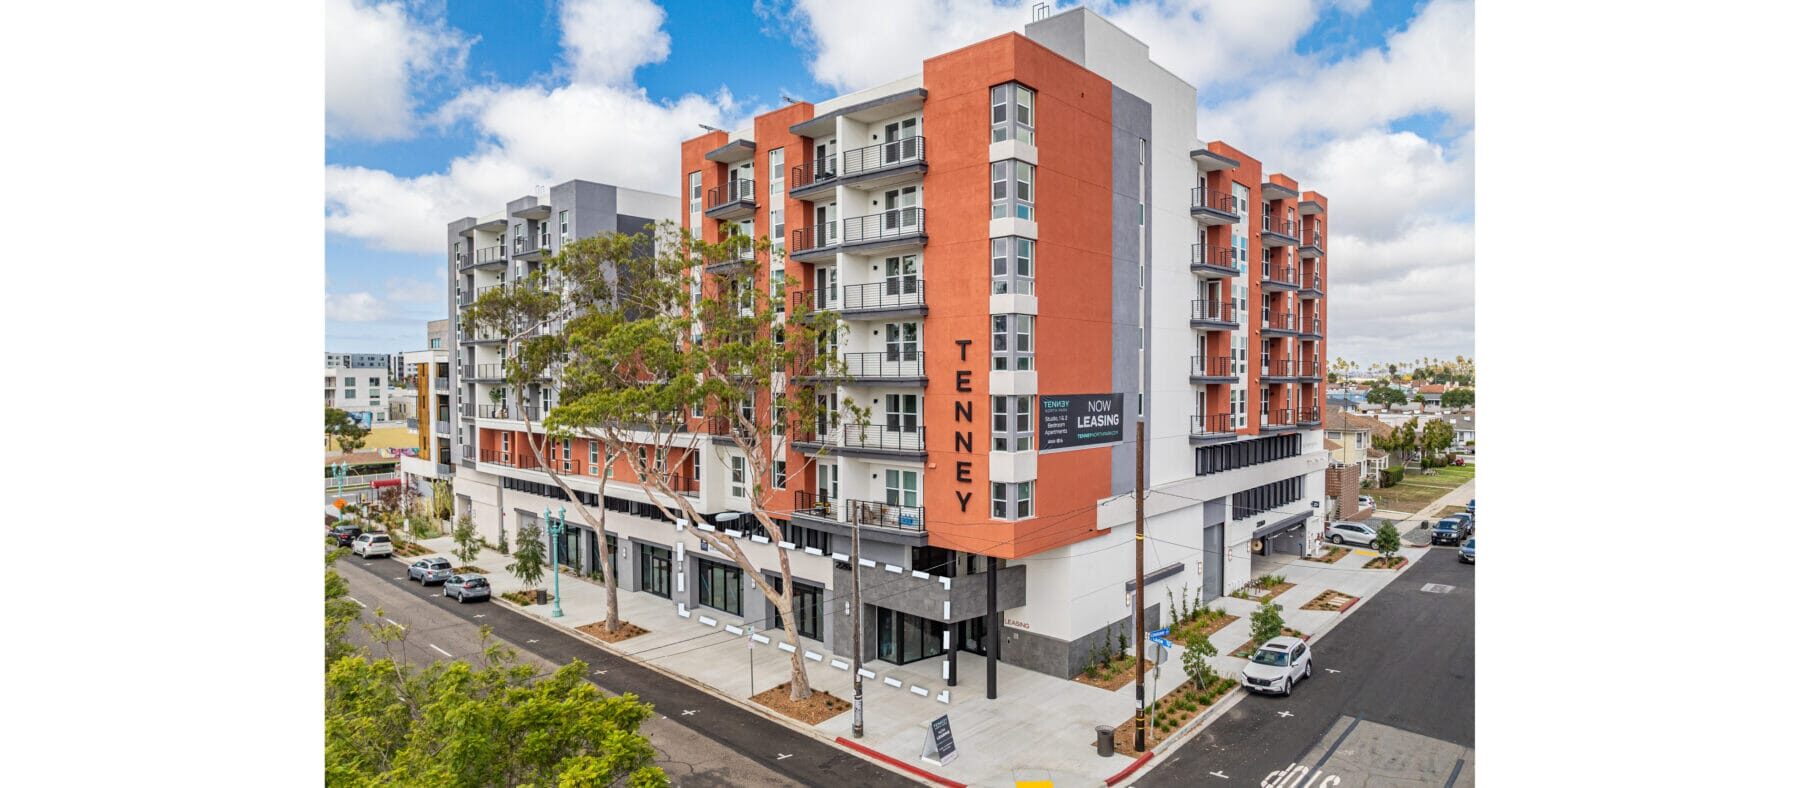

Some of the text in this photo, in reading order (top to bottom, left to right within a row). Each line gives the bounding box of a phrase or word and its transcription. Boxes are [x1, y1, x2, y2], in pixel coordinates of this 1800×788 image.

[1088, 400, 1111, 412] NOW
[955, 340, 972, 513] TENNEY
[1077, 414, 1119, 428] LEASING
[1004, 618, 1030, 629] LEASING
